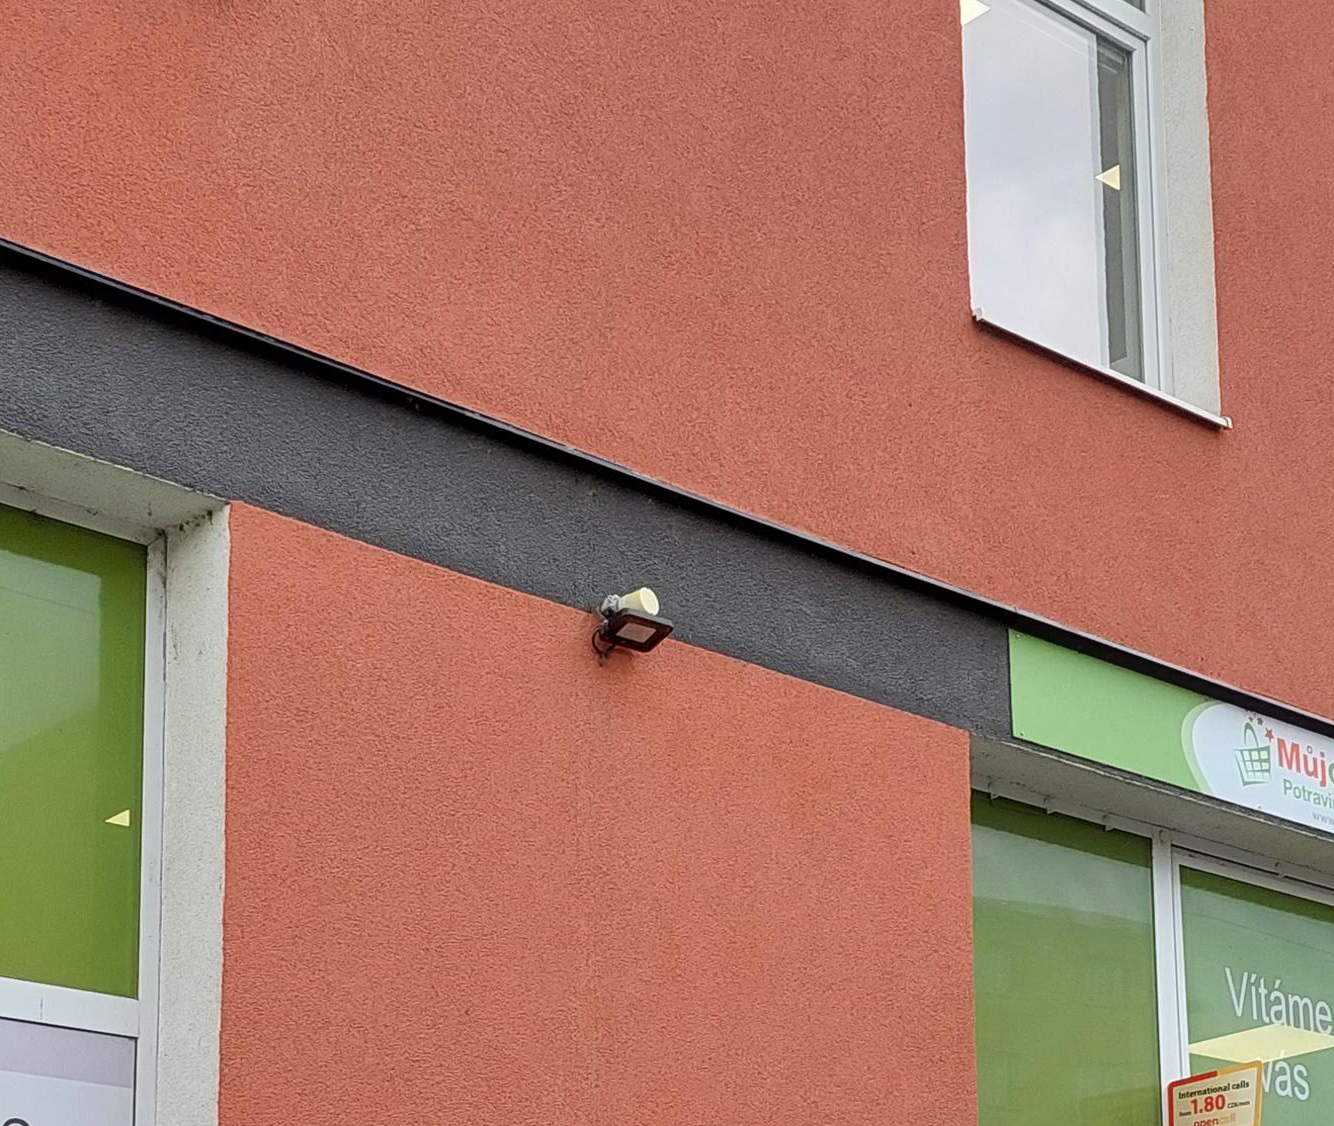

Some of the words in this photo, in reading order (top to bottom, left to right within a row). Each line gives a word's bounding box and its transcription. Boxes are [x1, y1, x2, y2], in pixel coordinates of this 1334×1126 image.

[1224, 967, 1334, 1036] Vítáme
[1178, 1083, 1231, 1099] International
[1231, 1080, 1250, 1090] calls
[1190, 1094, 1225, 1115] 1.80
